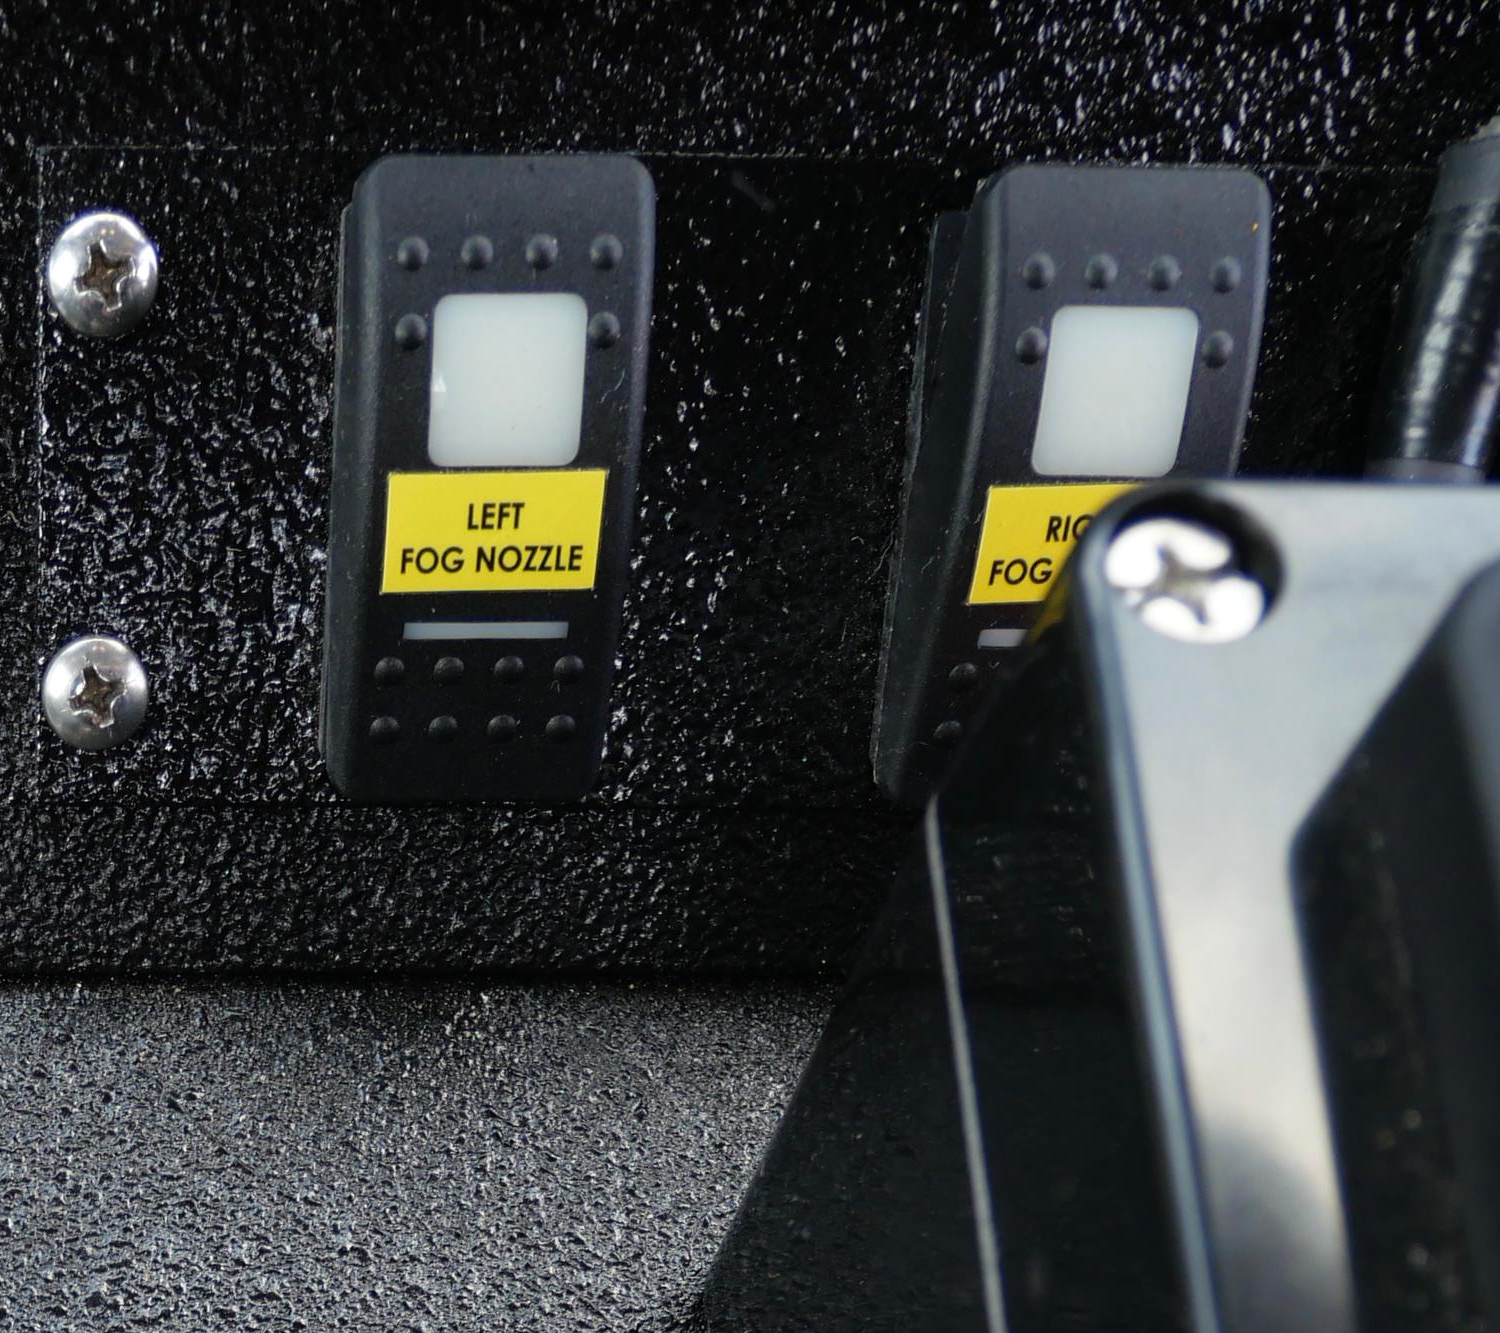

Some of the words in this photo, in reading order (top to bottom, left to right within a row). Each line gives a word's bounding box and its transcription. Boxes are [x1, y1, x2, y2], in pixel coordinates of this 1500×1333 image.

[467, 502, 524, 530] LEFT
[400, 547, 464, 574] FOG
[475, 545, 583, 573] NOZZLE
[988, 558, 1053, 586] FOG
